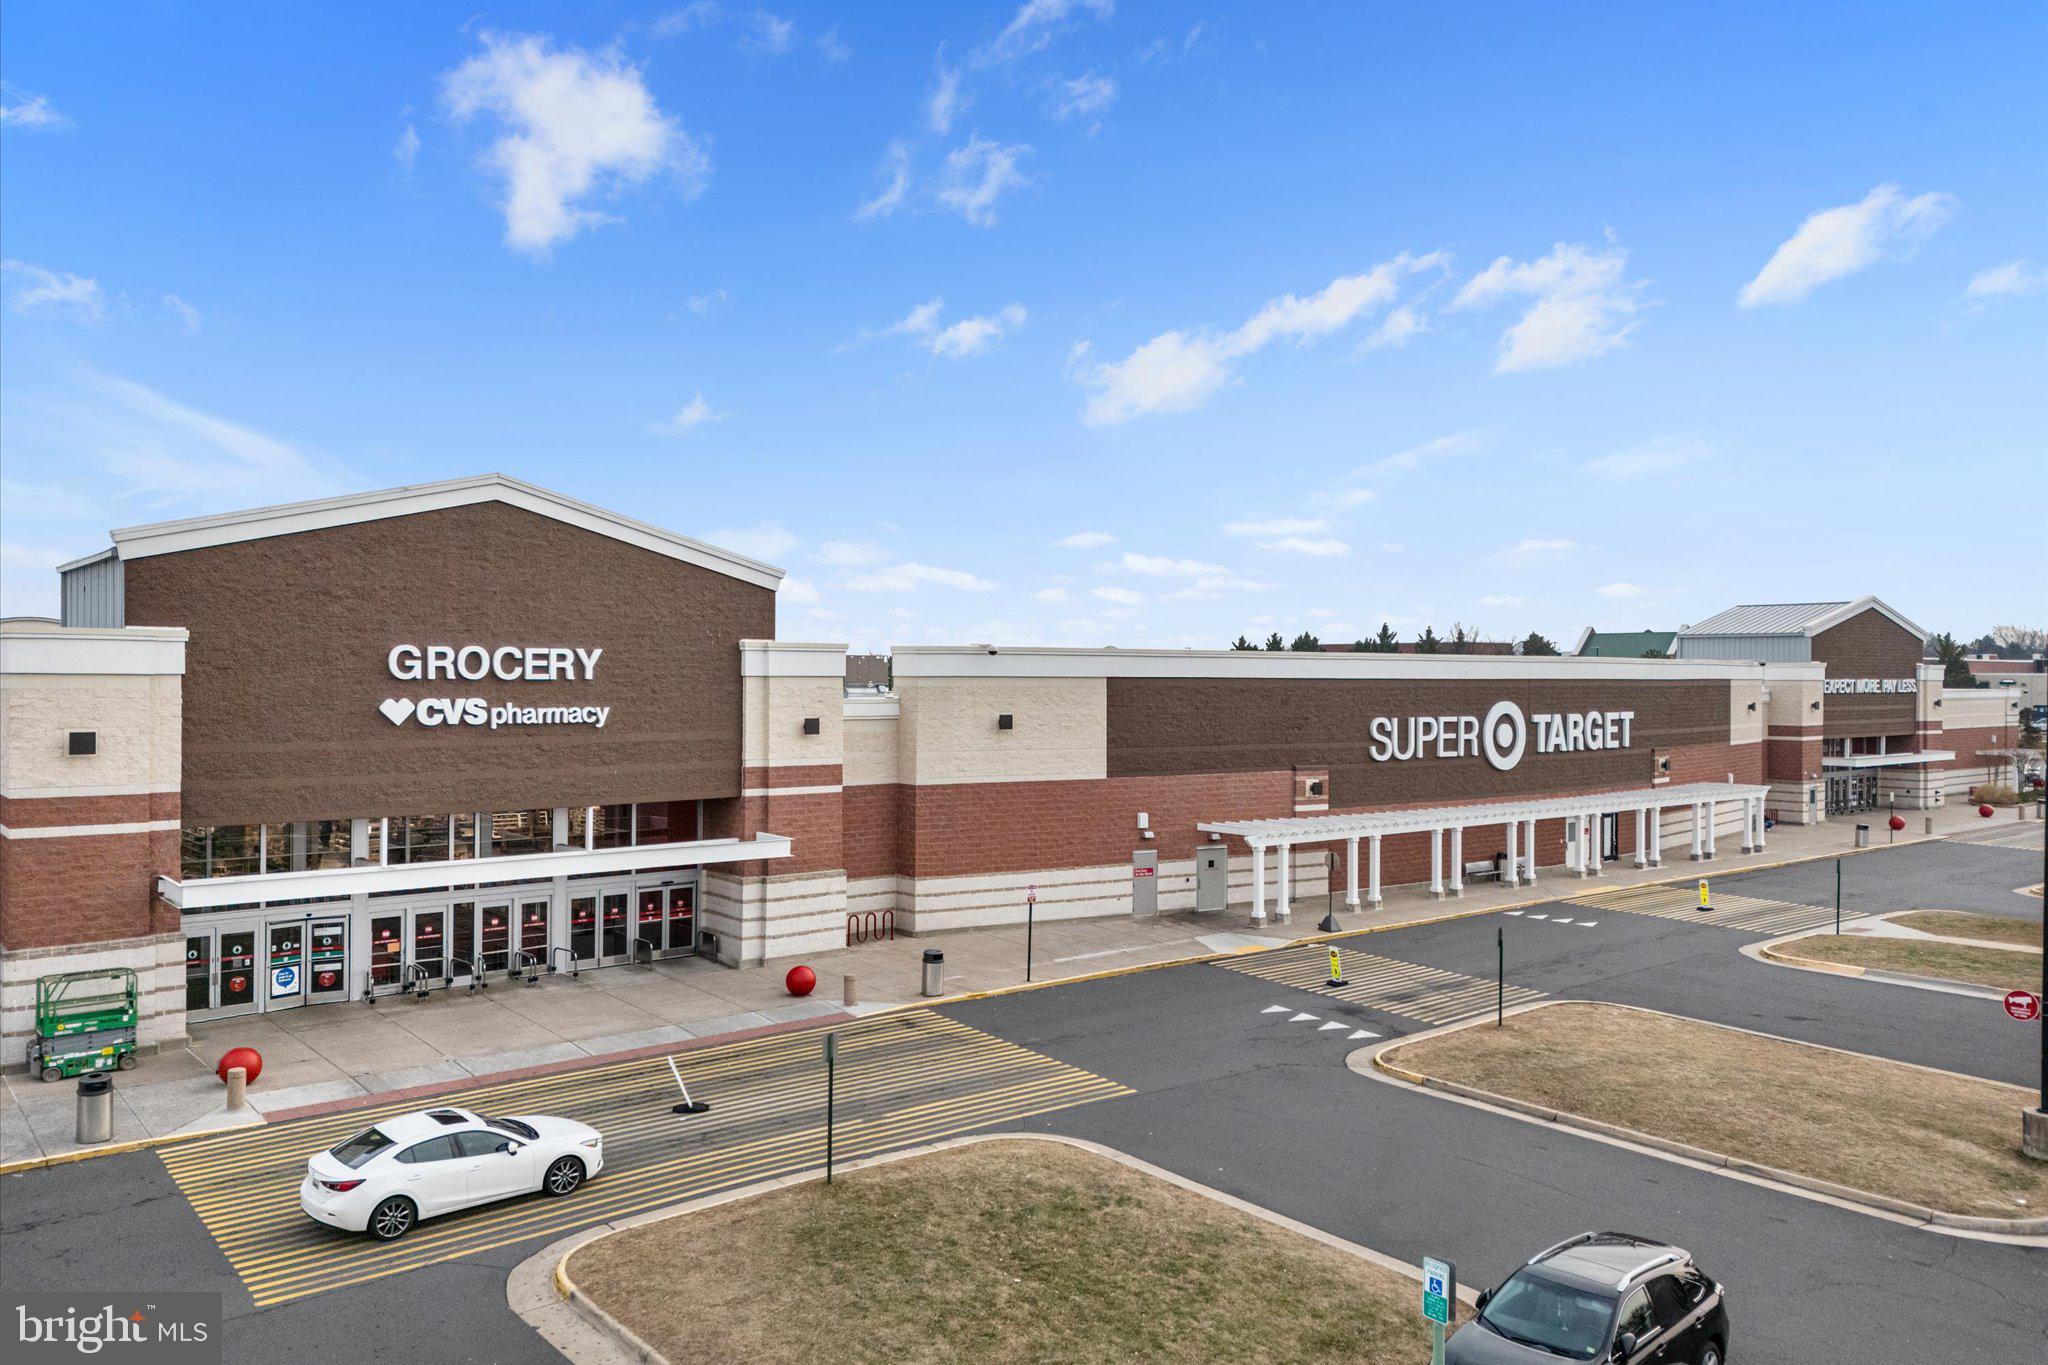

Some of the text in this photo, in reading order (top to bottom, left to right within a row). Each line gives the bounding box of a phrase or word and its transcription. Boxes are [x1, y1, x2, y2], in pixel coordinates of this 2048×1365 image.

[388, 644, 603, 681] GROCERY
[1824, 679, 1855, 694] EXPECT
[1883, 678, 1898, 693] PAY
[416, 698, 610, 729] CVS pharmacy
[1369, 711, 1635, 762] SUPER TARGET
